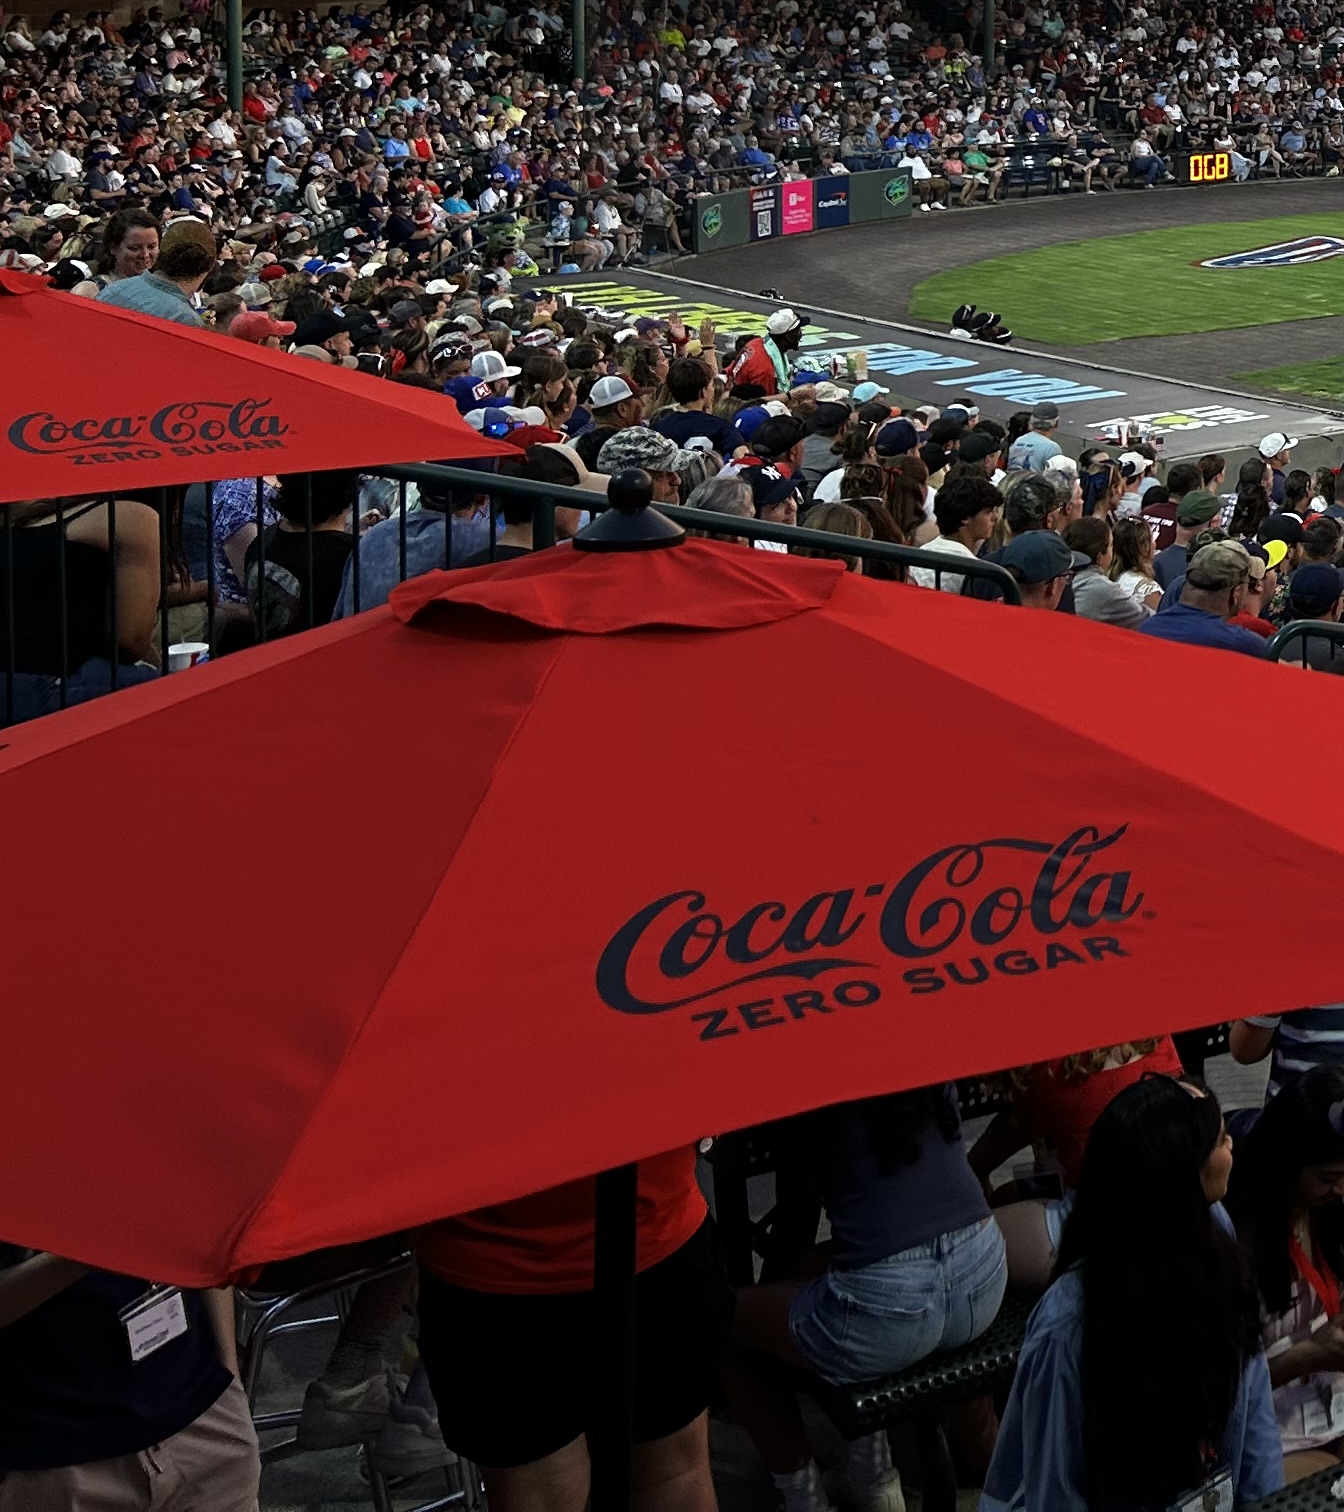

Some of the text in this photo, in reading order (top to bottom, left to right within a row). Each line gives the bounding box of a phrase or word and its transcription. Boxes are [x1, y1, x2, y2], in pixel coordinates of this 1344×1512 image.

[932, 368, 1128, 406] YOU
[8, 398, 290, 454] Coca-Cola
[68, 439, 289, 466] ZERO SUGAR
[595, 821, 1145, 1015] Coca-Cola
[691, 935, 1131, 1041] ZERO SUGAR
